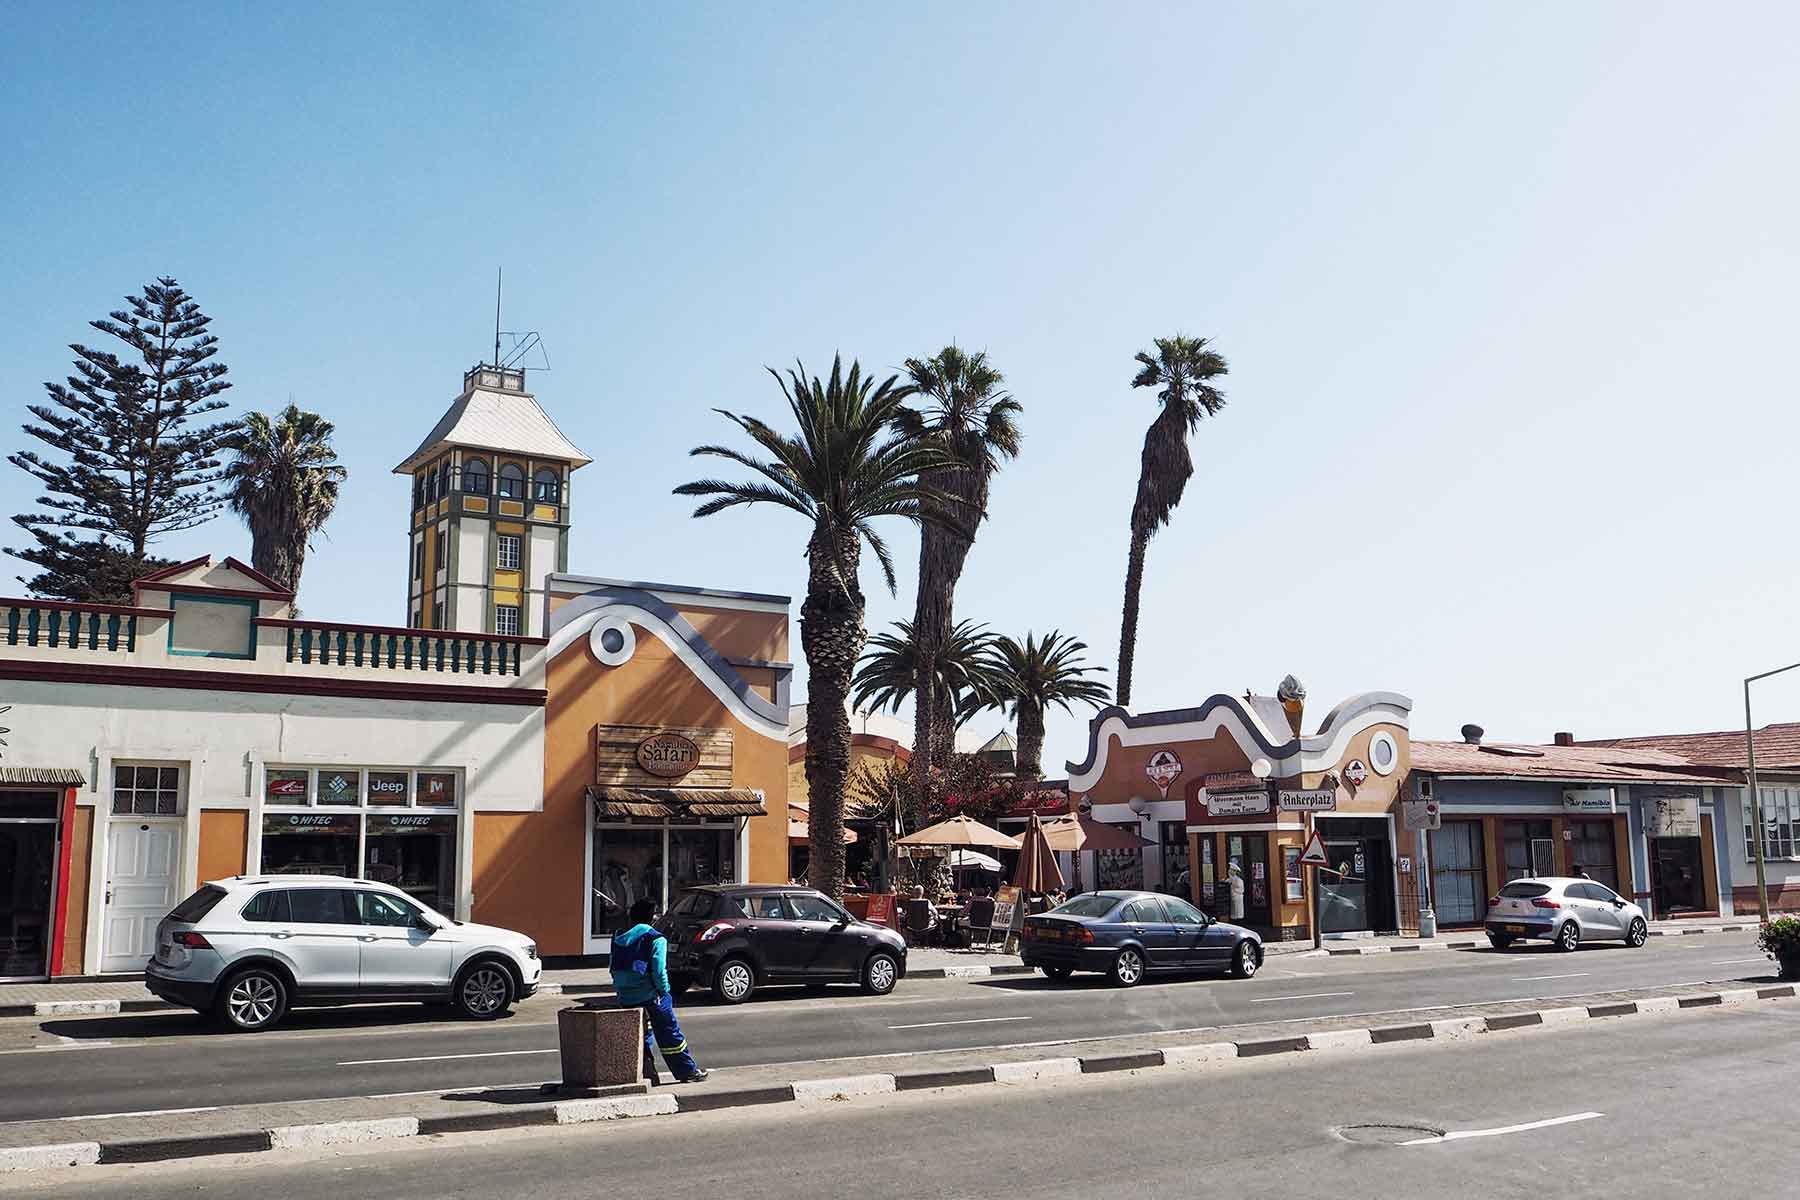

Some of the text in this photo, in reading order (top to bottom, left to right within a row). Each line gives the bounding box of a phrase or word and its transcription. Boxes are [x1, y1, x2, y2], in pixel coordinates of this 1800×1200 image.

[643, 743, 693, 762] Safari
[371, 779, 404, 793] Jeep
[1283, 793, 1331, 807] Ankerplatz
[299, 816, 333, 825] HI-TEC
[399, 816, 431, 825] HI-TEC
